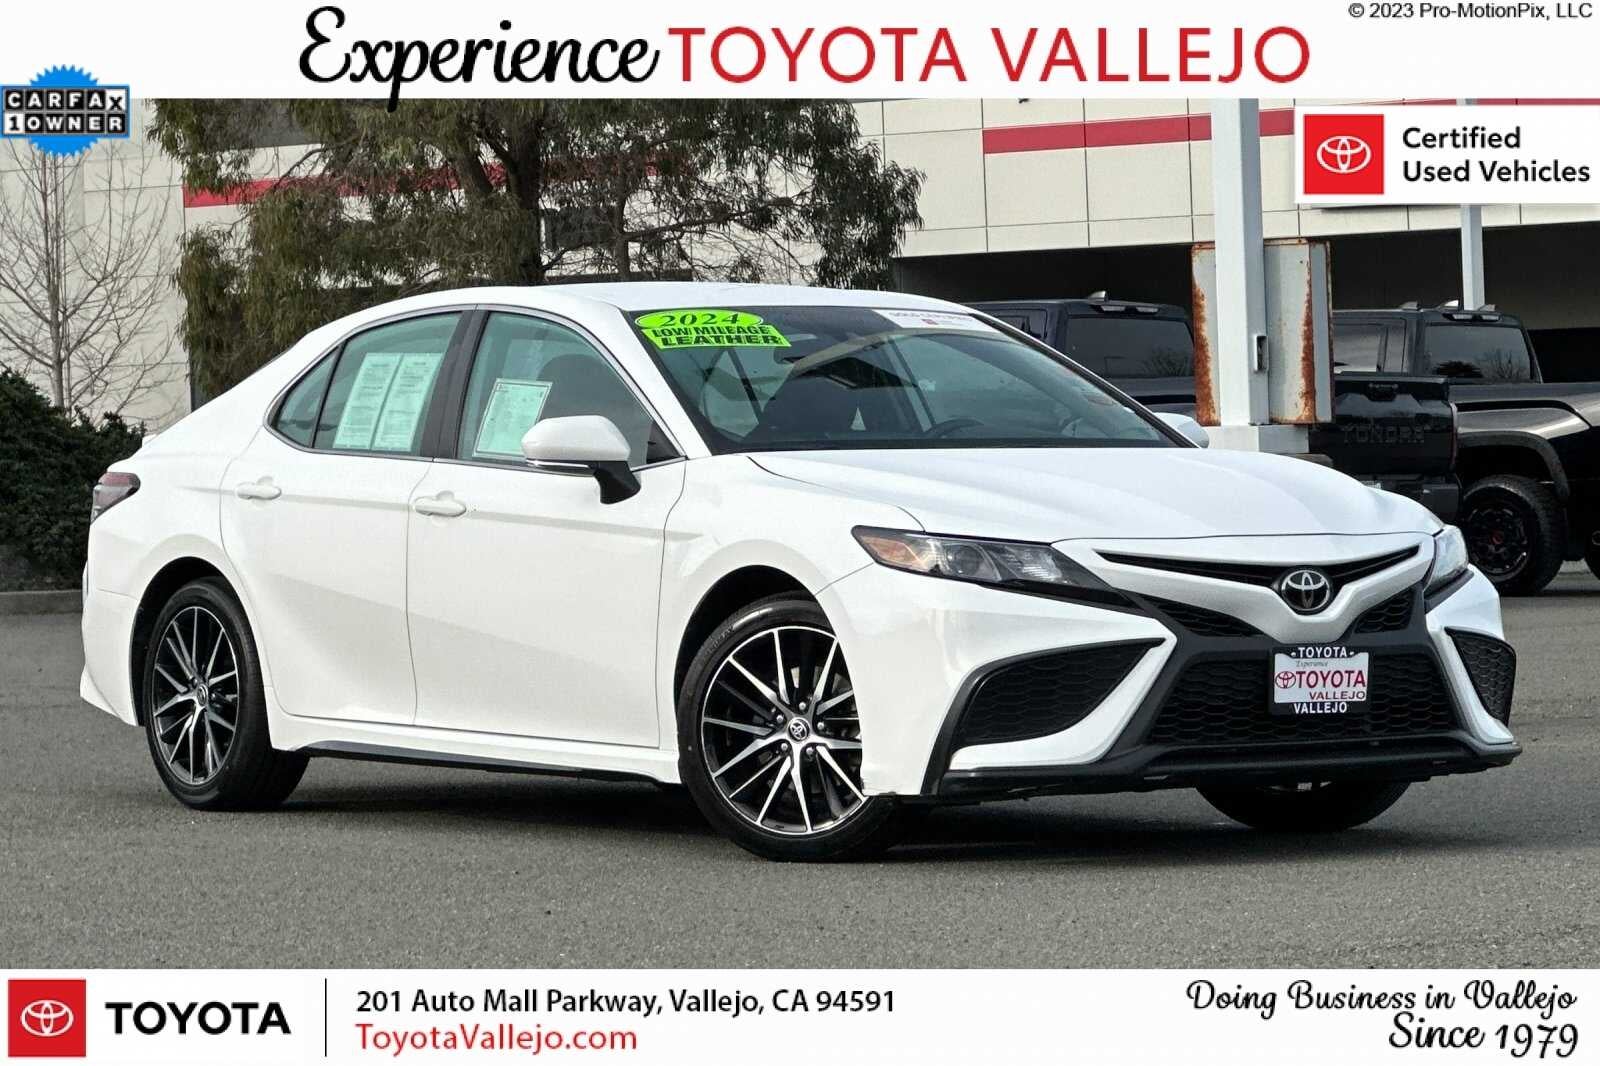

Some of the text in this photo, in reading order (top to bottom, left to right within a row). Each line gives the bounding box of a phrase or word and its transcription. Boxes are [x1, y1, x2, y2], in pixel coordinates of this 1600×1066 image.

[660, 313, 740, 327] 2024
[652, 325, 770, 338] LOW MILEAGE
[661, 335, 783, 346] LEATHER
[1298, 647, 1347, 658] TOYOTA
[1296, 670, 1366, 689] TOYOTA
[1309, 690, 1366, 700] VALLEJO
[1294, 702, 1347, 714] VALLEJO
